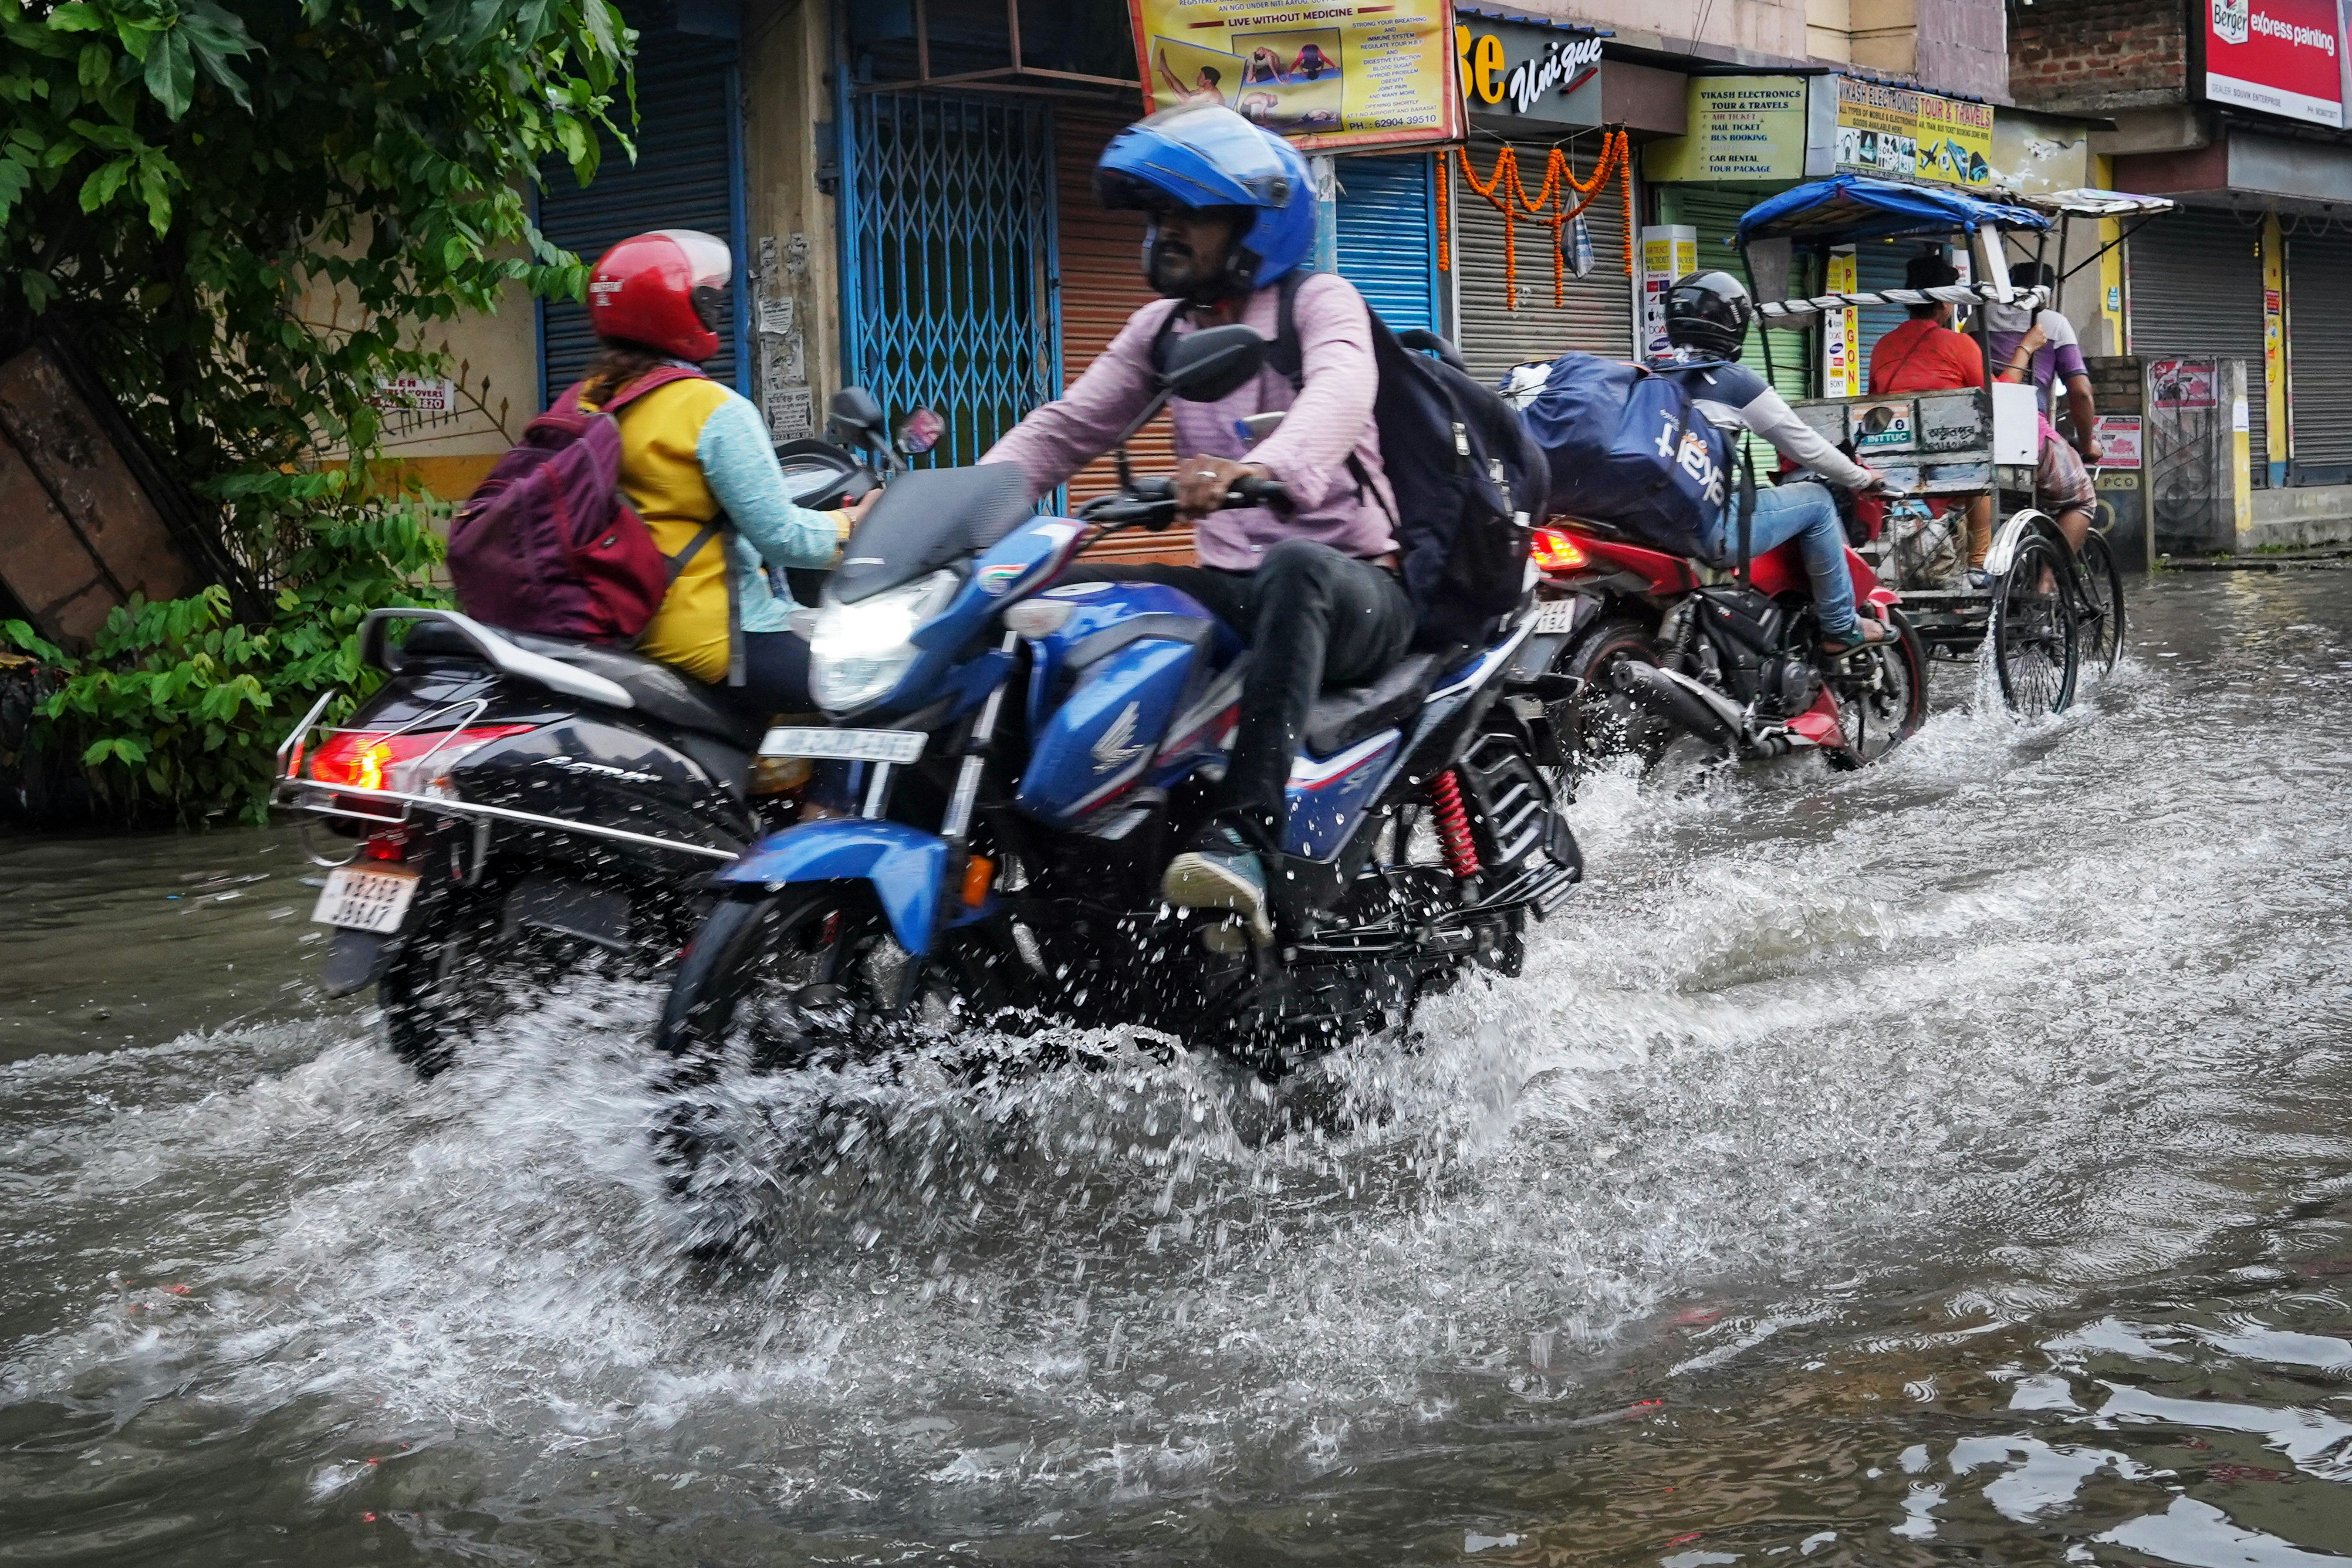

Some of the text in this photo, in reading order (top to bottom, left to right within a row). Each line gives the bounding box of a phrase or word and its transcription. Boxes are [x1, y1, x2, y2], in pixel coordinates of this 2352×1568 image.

[1229, 8, 1353, 27] LIVE WITHOUT MEDICINE
[2215, 4, 2335, 57] Berger express painting
[1510, 37, 1603, 113] Unique
[1738, 90, 1801, 98] ELECTRONICS
[1839, 81, 1919, 115] VIKASH ELECTRONICS
[2252, 92, 2281, 107] ENTERPRISE
[1375, 118, 1403, 128] 62904
[1406, 115, 1436, 125] 39510
[1920, 97, 1990, 129] TOUR & TRAVELS
